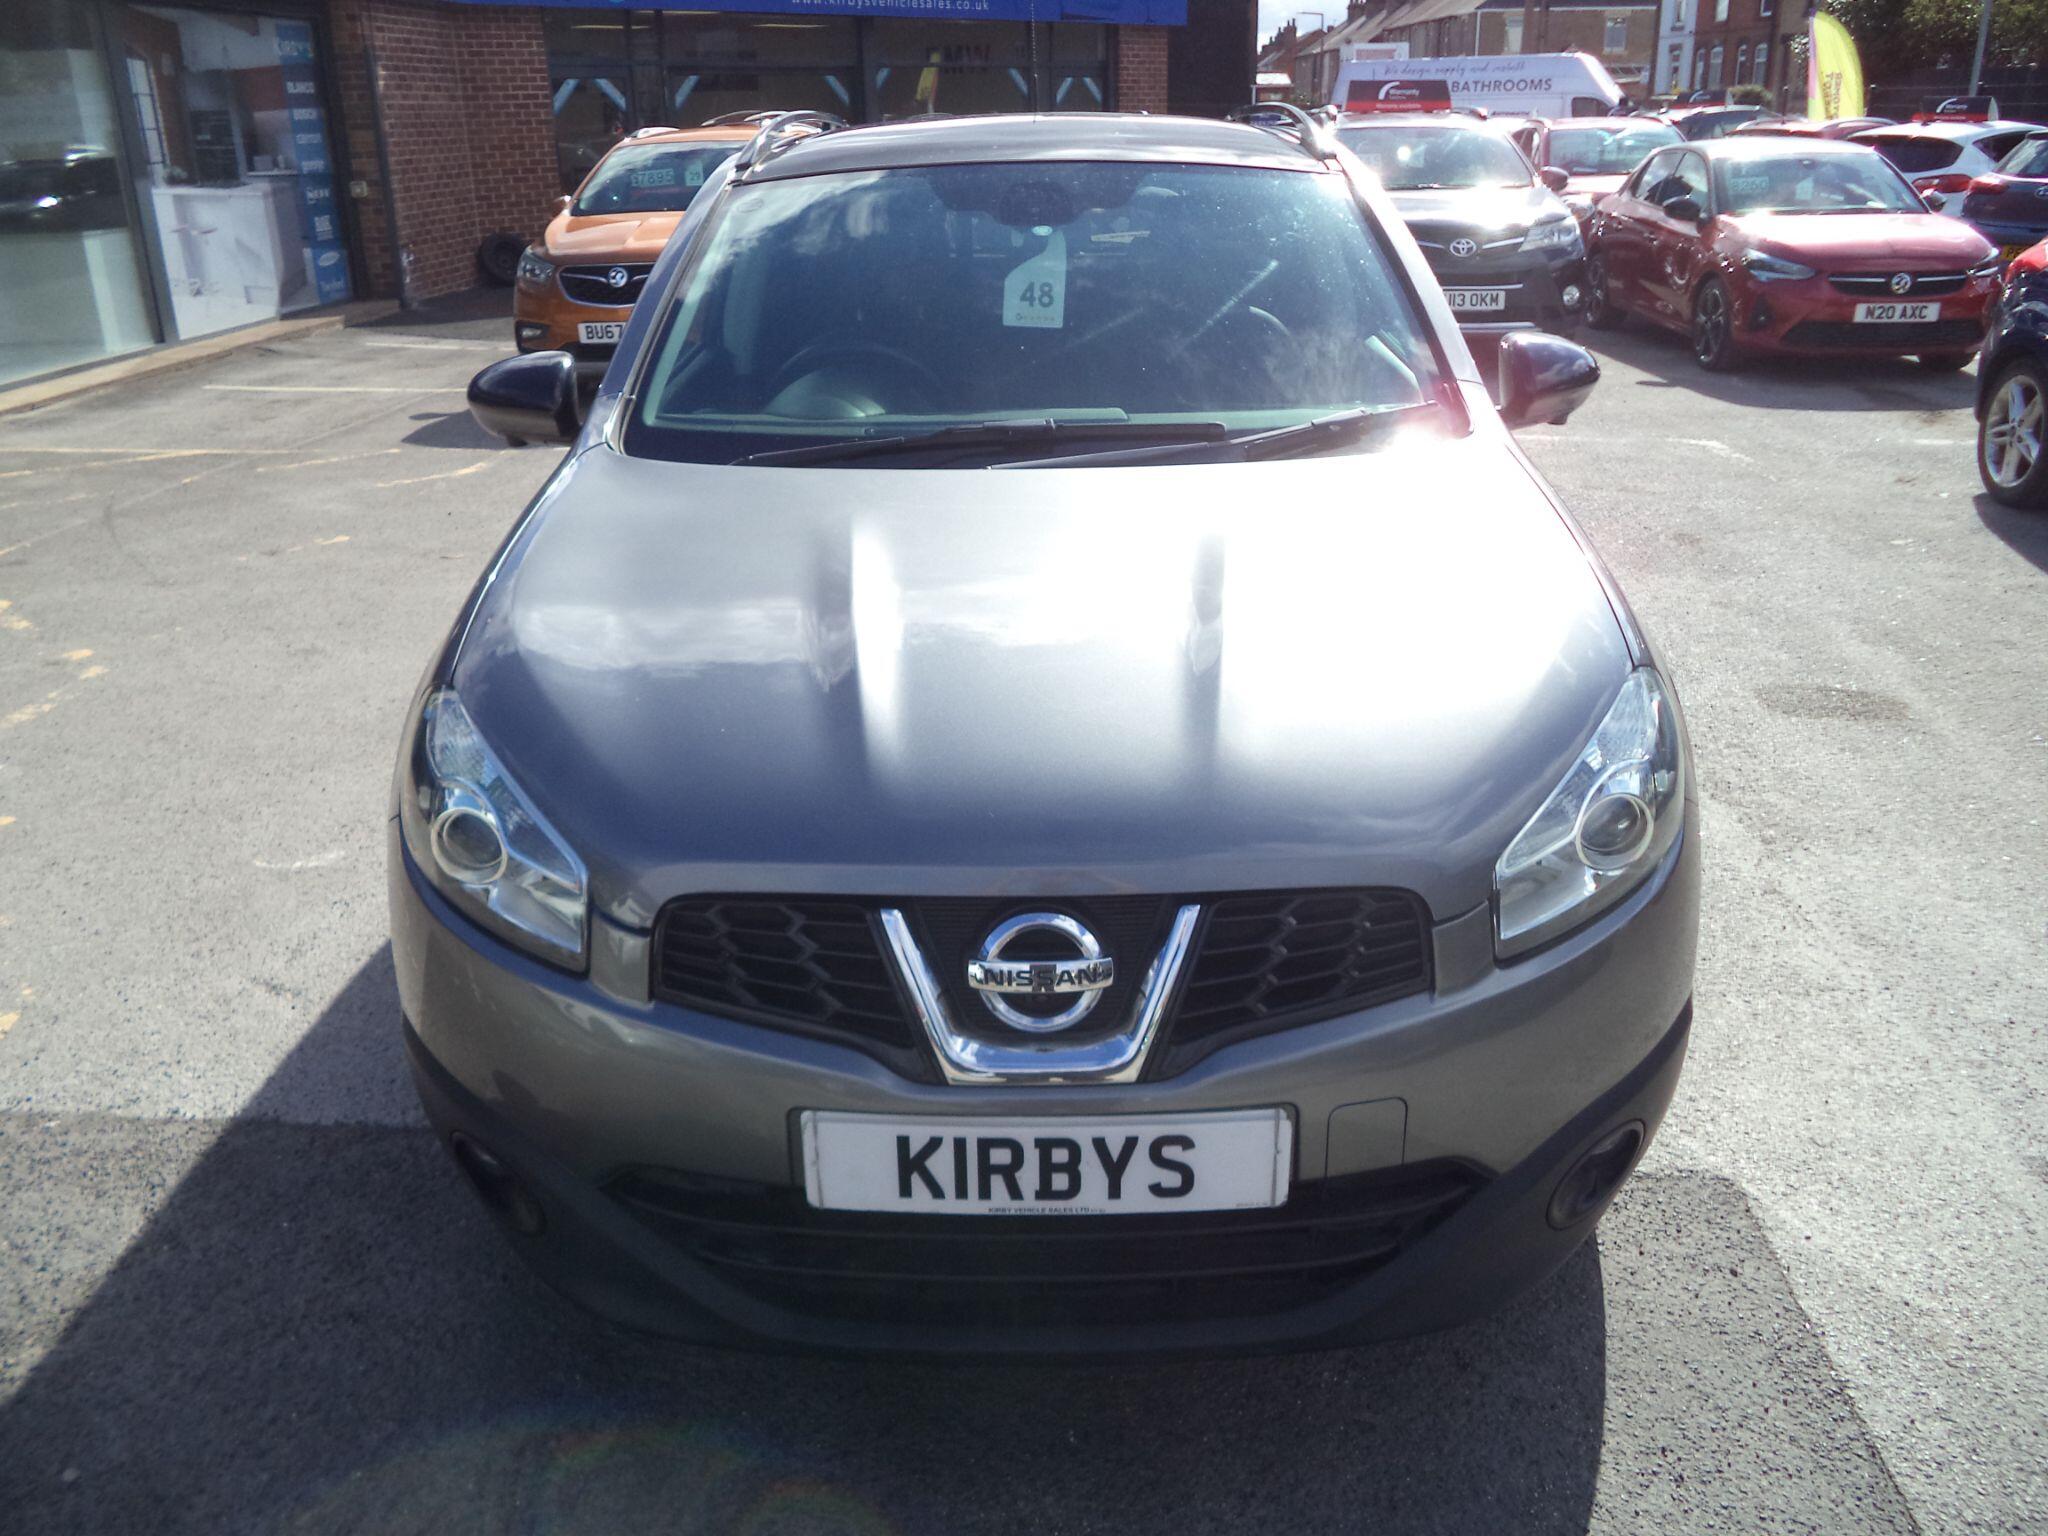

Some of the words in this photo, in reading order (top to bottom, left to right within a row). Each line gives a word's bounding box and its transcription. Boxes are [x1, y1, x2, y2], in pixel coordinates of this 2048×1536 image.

[1451, 78, 1552, 93] BATHROOMS
[1019, 281, 1054, 308] 48
[1470, 293, 1499, 307] OKM
[1864, 305, 1896, 320] N20
[1899, 305, 1928, 319] AXC
[585, 325, 623, 340] BU67
[983, 966, 1099, 988] NISSAN
[896, 1134, 1196, 1200] KIRBYS
